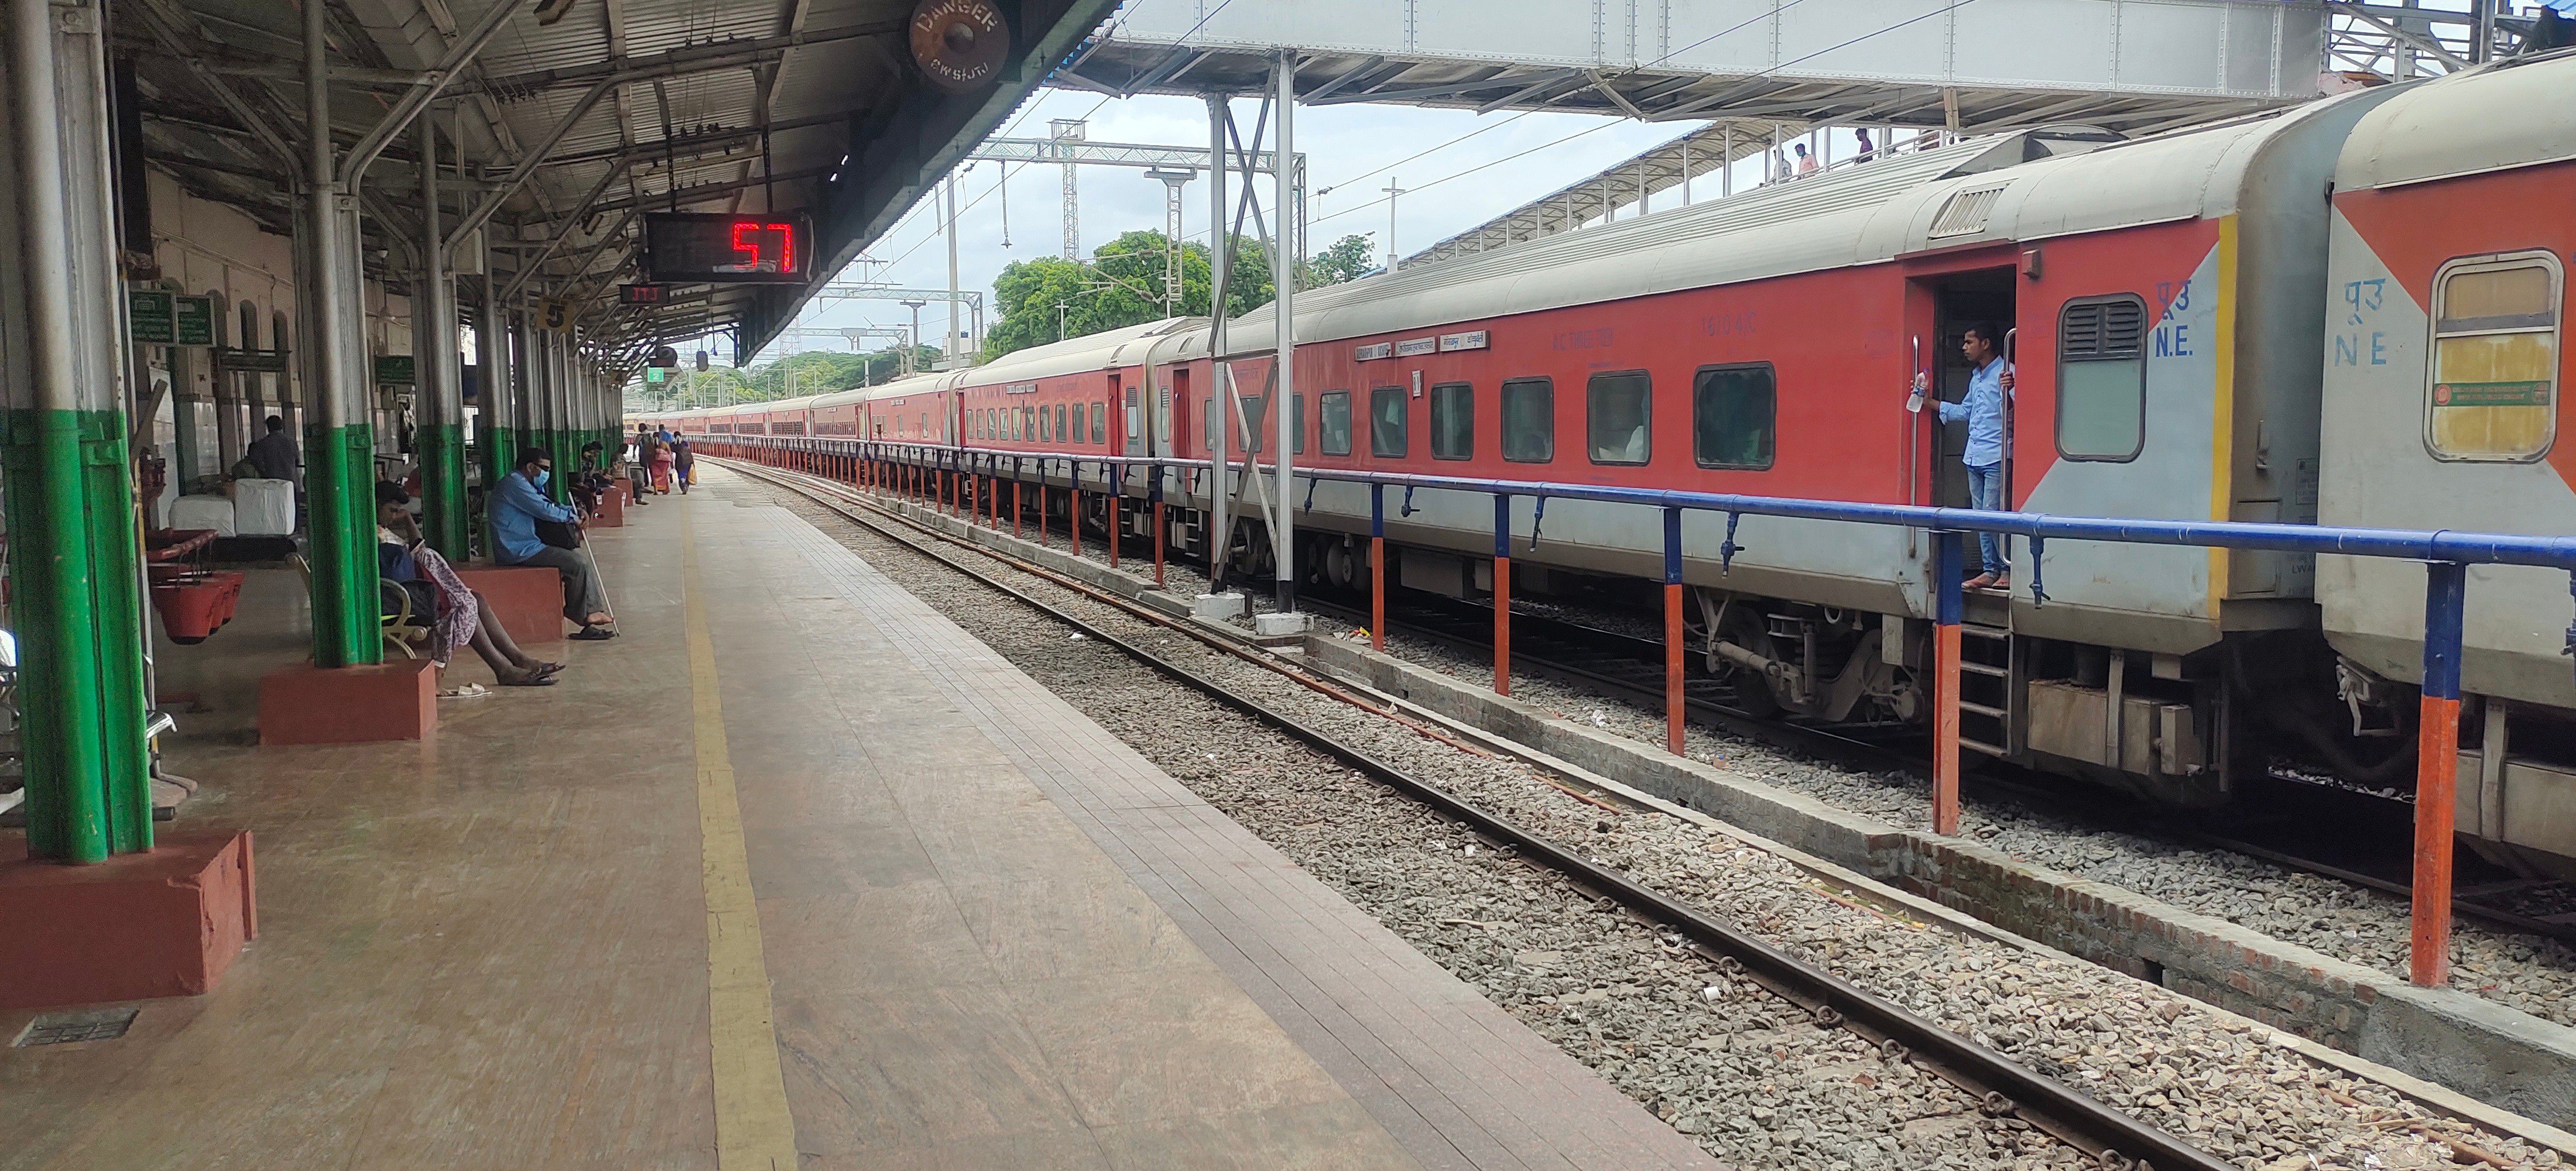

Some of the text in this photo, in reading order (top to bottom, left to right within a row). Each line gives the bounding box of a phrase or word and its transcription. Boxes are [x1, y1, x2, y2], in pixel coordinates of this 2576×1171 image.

[916, 0, 998, 32] DANGER
[732, 222, 792, 272] 57
[546, 304, 566, 328] 5
[2155, 324, 2193, 358] N.E.
